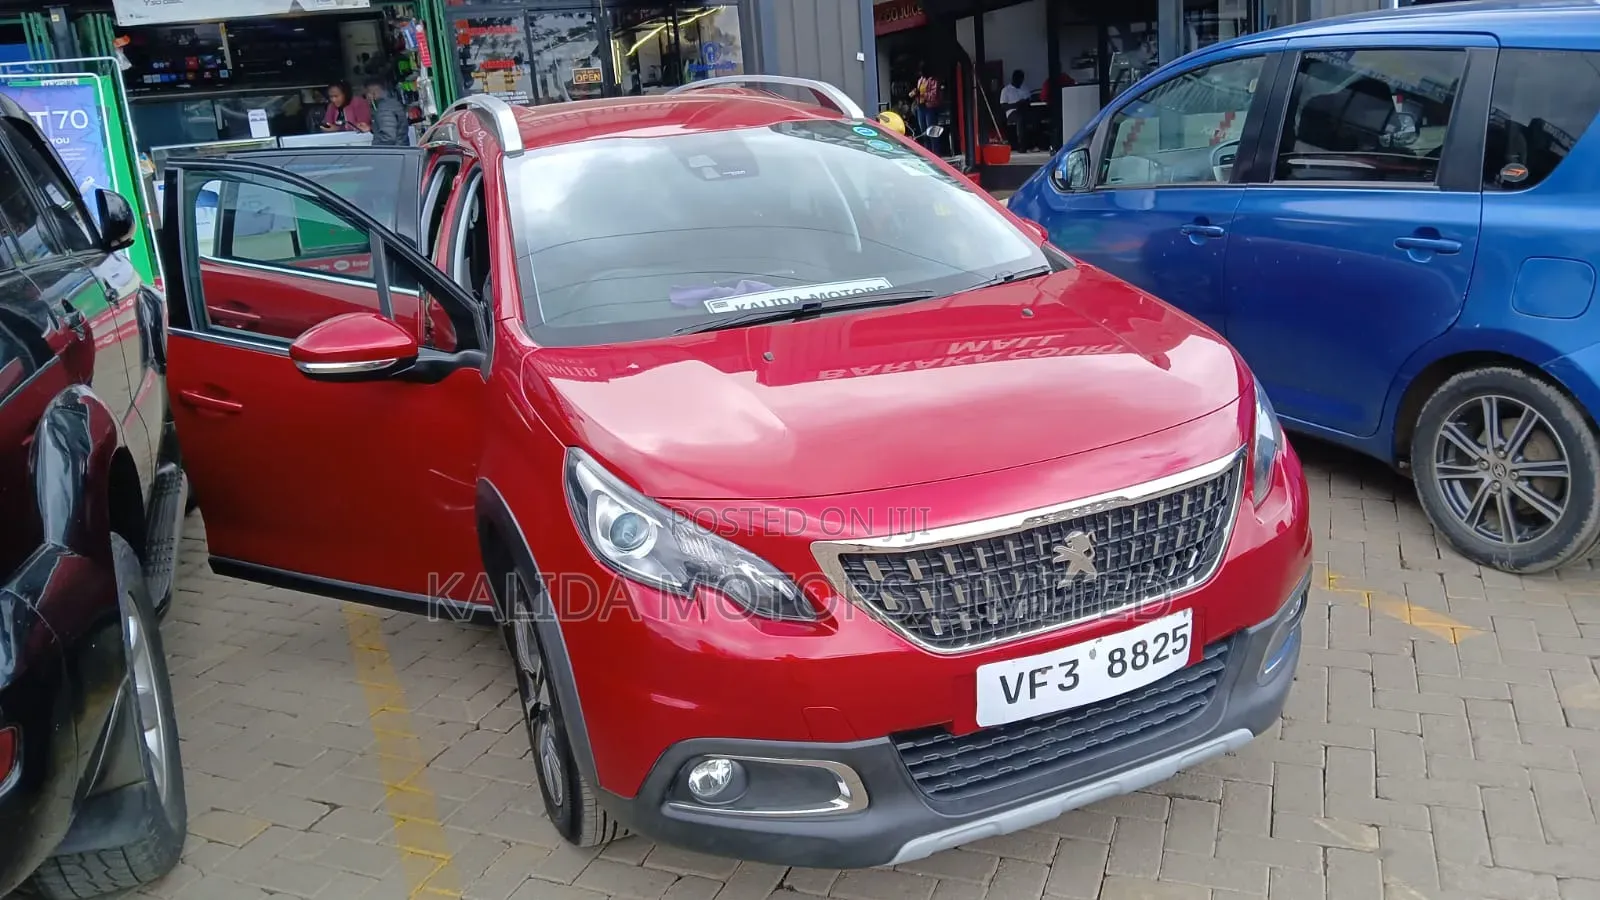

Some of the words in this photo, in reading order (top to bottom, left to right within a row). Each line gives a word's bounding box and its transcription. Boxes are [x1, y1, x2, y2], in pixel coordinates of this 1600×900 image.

[575, 72, 601, 82] OPEN
[52, 109, 89, 130] 70
[1000, 659, 1079, 704] VF3
[1107, 622, 1189, 678] 8825
